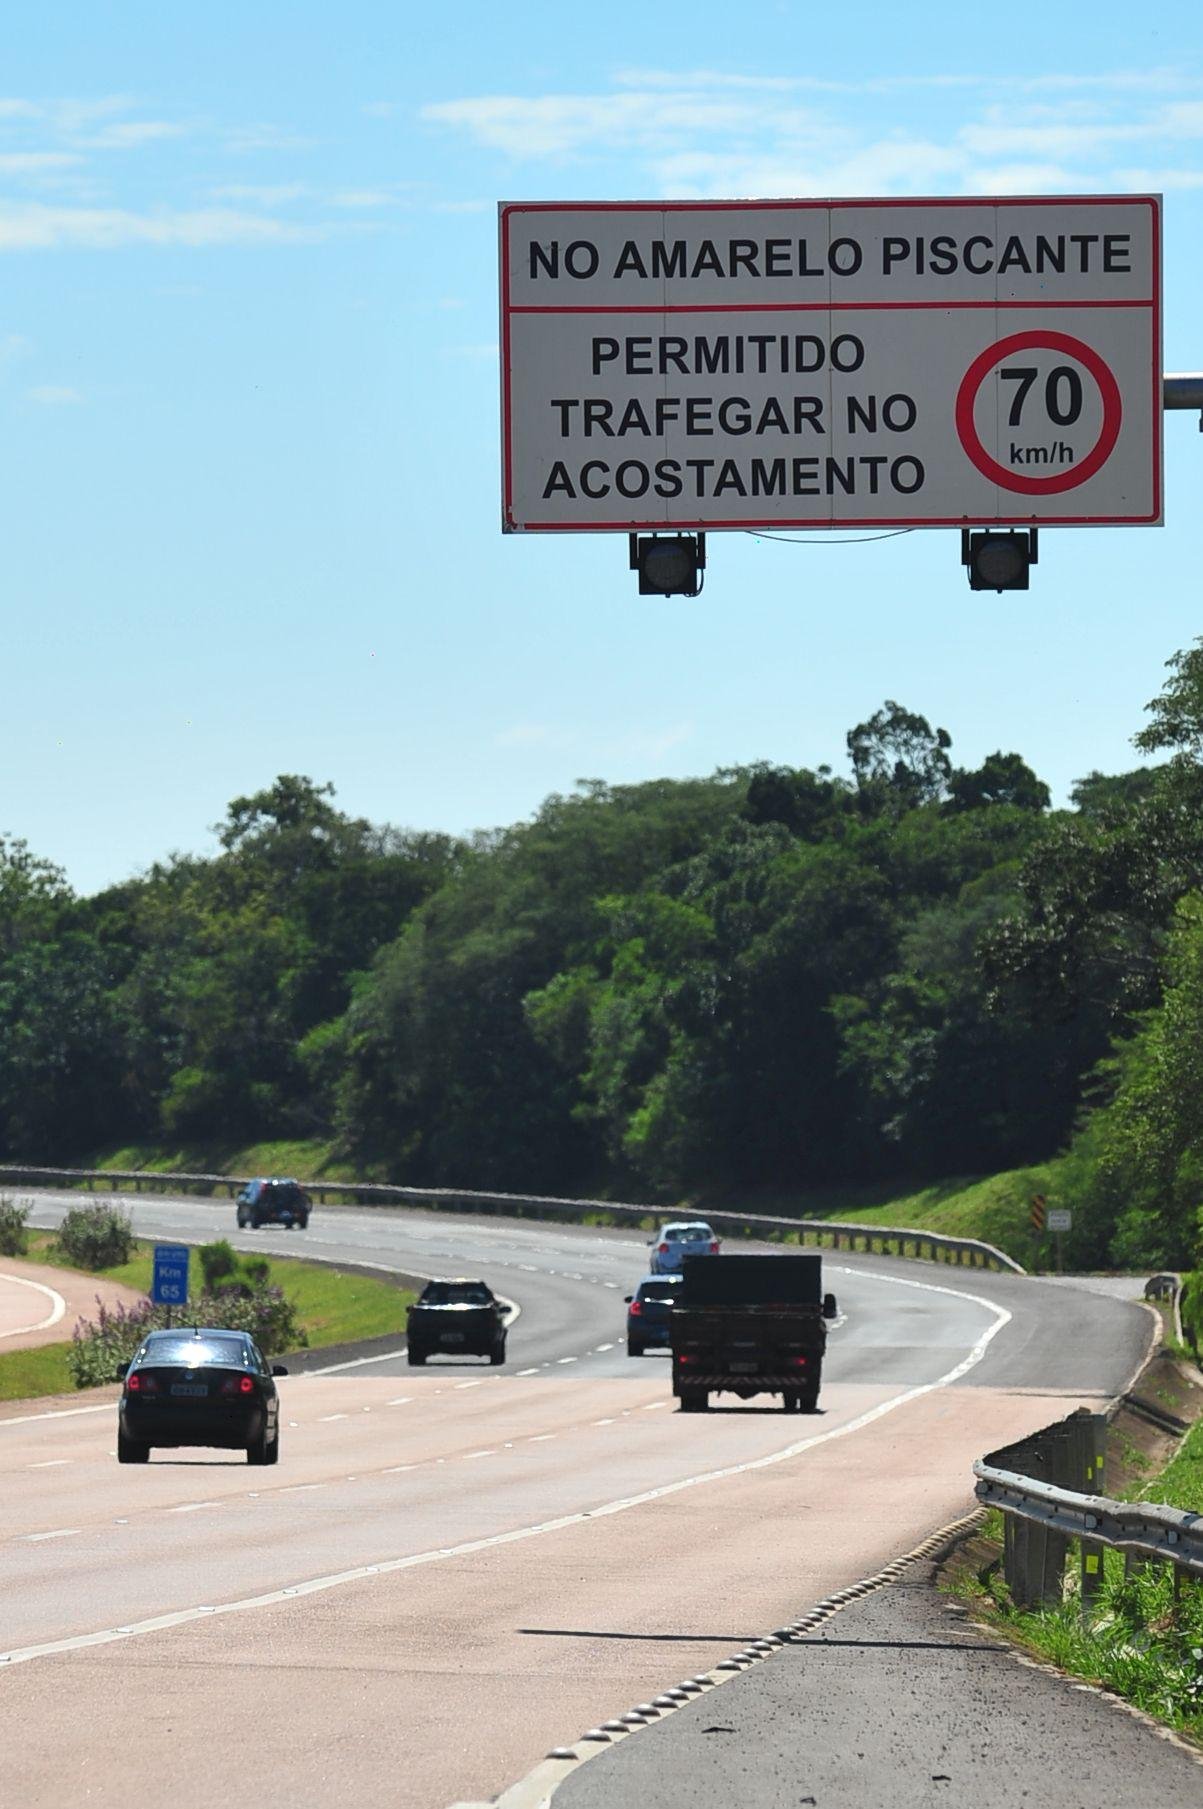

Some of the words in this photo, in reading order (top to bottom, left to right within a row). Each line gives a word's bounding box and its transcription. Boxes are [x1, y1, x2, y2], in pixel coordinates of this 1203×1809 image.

[529, 240, 600, 280] NO
[612, 237, 863, 279] AMARELO
[882, 234, 1132, 276] PISCANTE
[591, 333, 865, 376] PERMITIDO
[550, 396, 826, 438] TRAFEGAR
[846, 393, 917, 434] NO
[1000, 365, 1083, 427] 70
[1010, 441, 1074, 465] km/h
[541, 454, 925, 499] ACOSTAMENTO
[160, 1285, 180, 1298] 65
